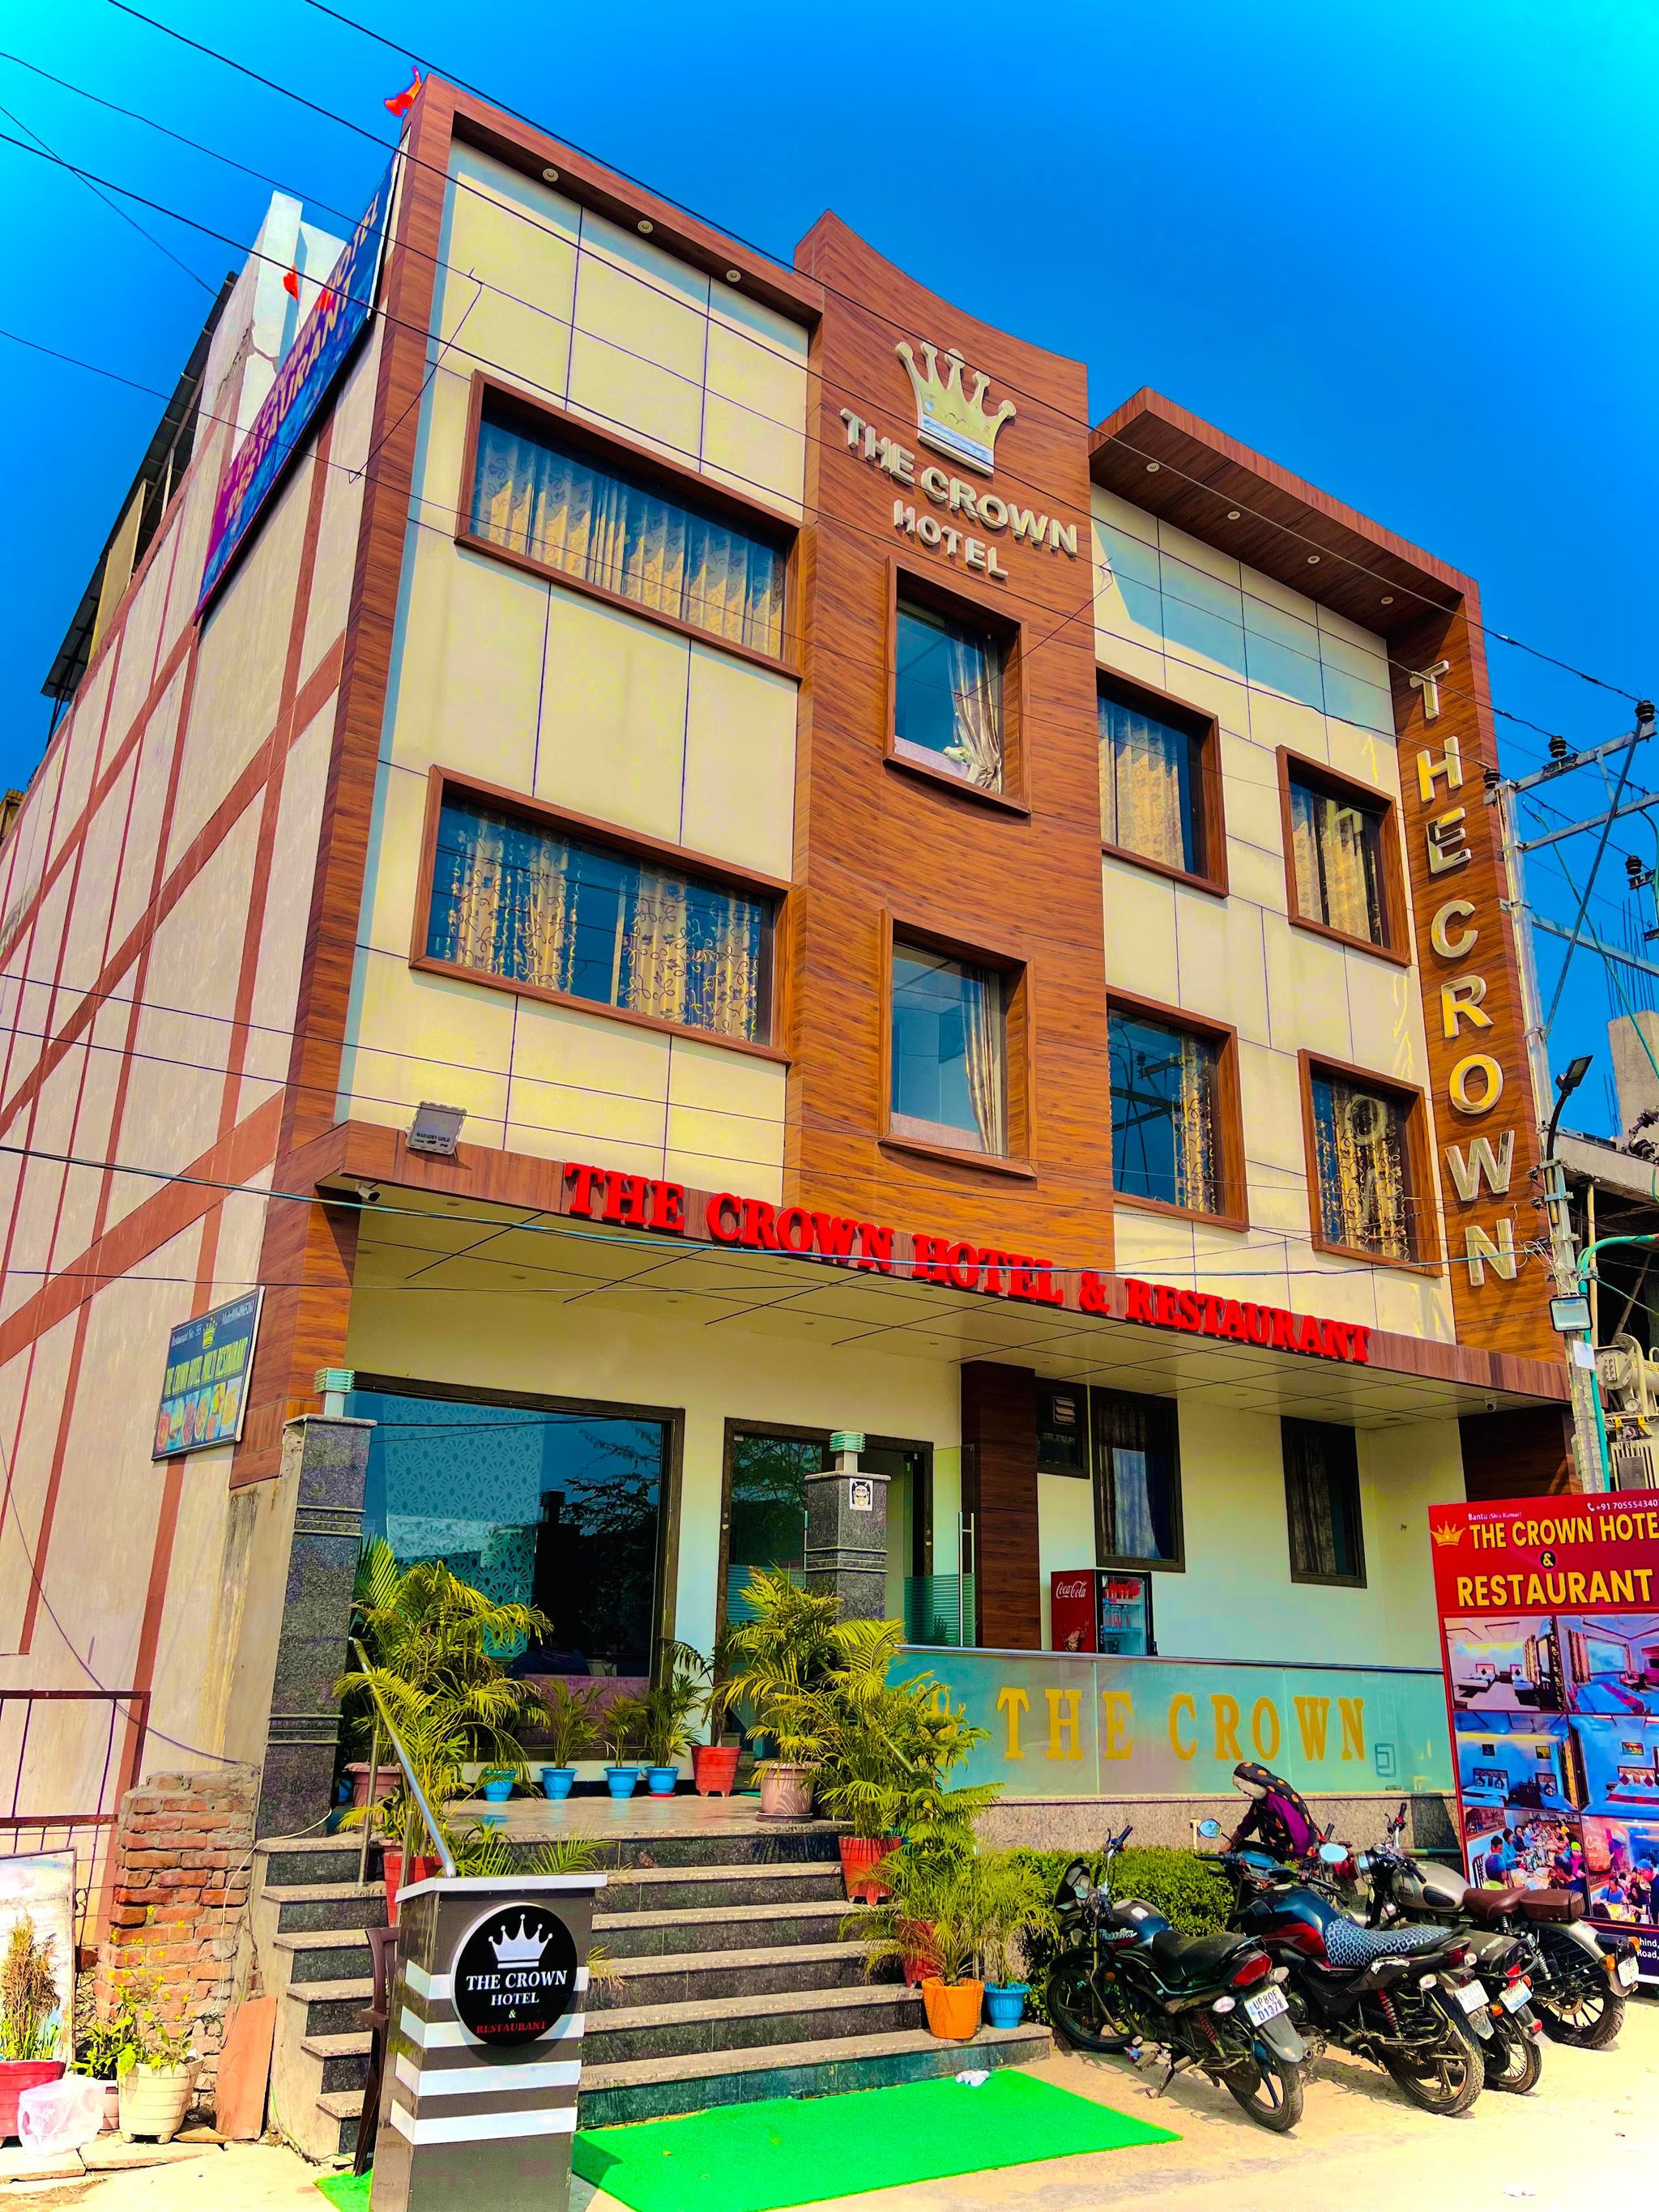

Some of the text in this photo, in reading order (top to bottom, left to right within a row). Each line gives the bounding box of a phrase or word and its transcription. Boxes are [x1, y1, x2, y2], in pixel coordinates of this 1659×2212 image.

[224, 262, 357, 529] RESTAURANT
[840, 407, 1078, 557] THE CROWN
[893, 499, 1008, 579] HOTEL
[565, 1162, 1371, 1364] THE CROWN HOTEL & RESTAURANT
[1468, 1512, 1488, 1521] Bantu
[1596, 1498, 1659, 1511] +91 705554340
[1469, 1511, 1659, 1549] THE CROWN HOTE
[1542, 1553, 1554, 1566] &
[1457, 1569, 1653, 1607] RESTAURANT
[996, 1686, 1366, 1761] THE CROWN
[466, 1970, 567, 1991] THE CROWN
[491, 1992, 539, 2005] HOTEL
[476, 2020, 546, 2034] RESTAURANT
[509, 2010, 517, 2018] &
